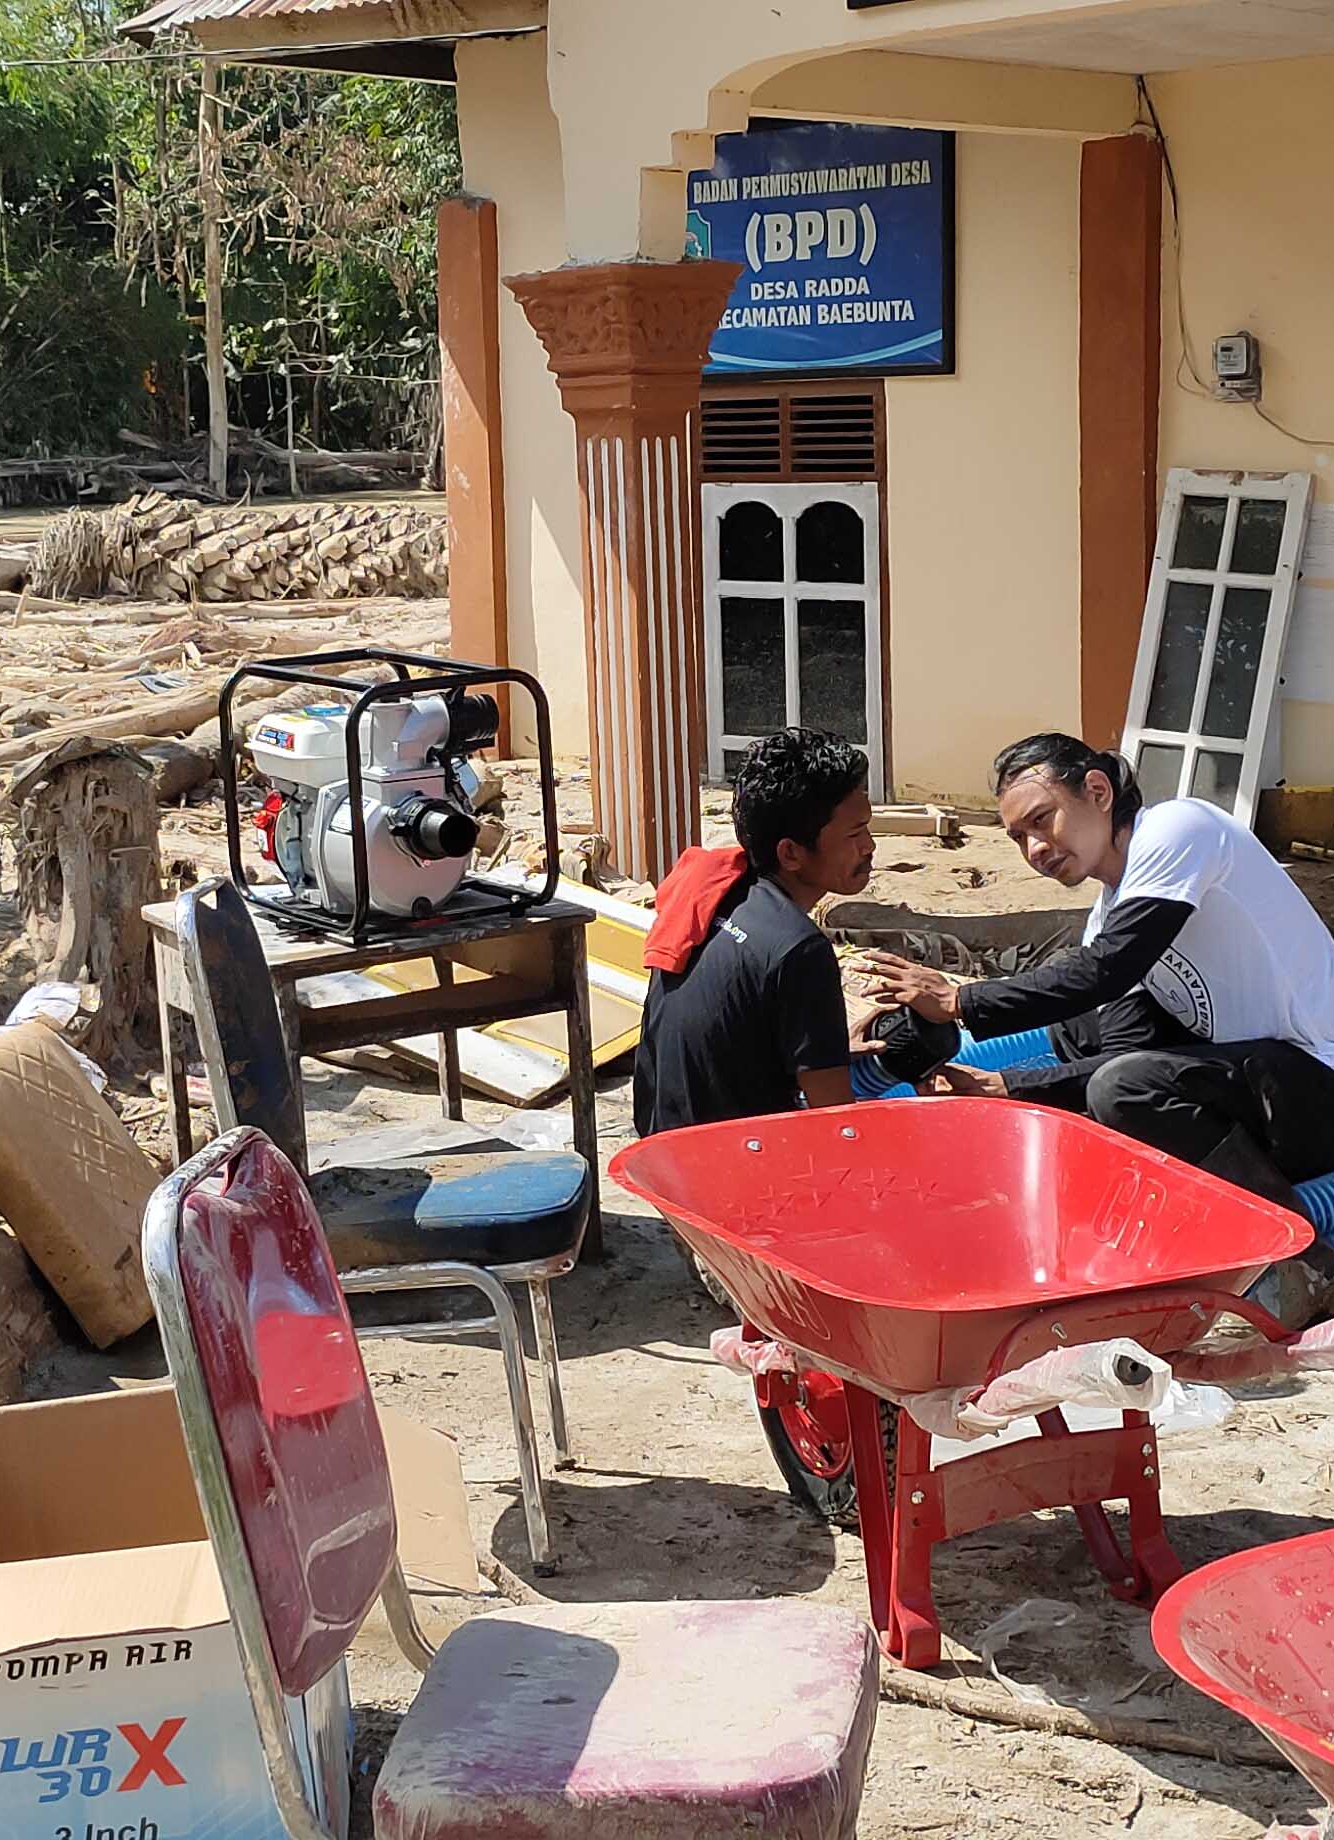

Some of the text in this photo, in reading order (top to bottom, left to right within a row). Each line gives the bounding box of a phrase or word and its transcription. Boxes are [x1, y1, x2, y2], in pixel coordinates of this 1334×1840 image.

[693, 160, 932, 205] BADAN PERMUSYAWARATAN DESA
[745, 203, 877, 273] (BPD)
[750, 276, 871, 301] DESA RADDA
[718, 299, 915, 330] ECAMATAN BAEBUNTA
[125, 1639, 194, 1668] AIR
